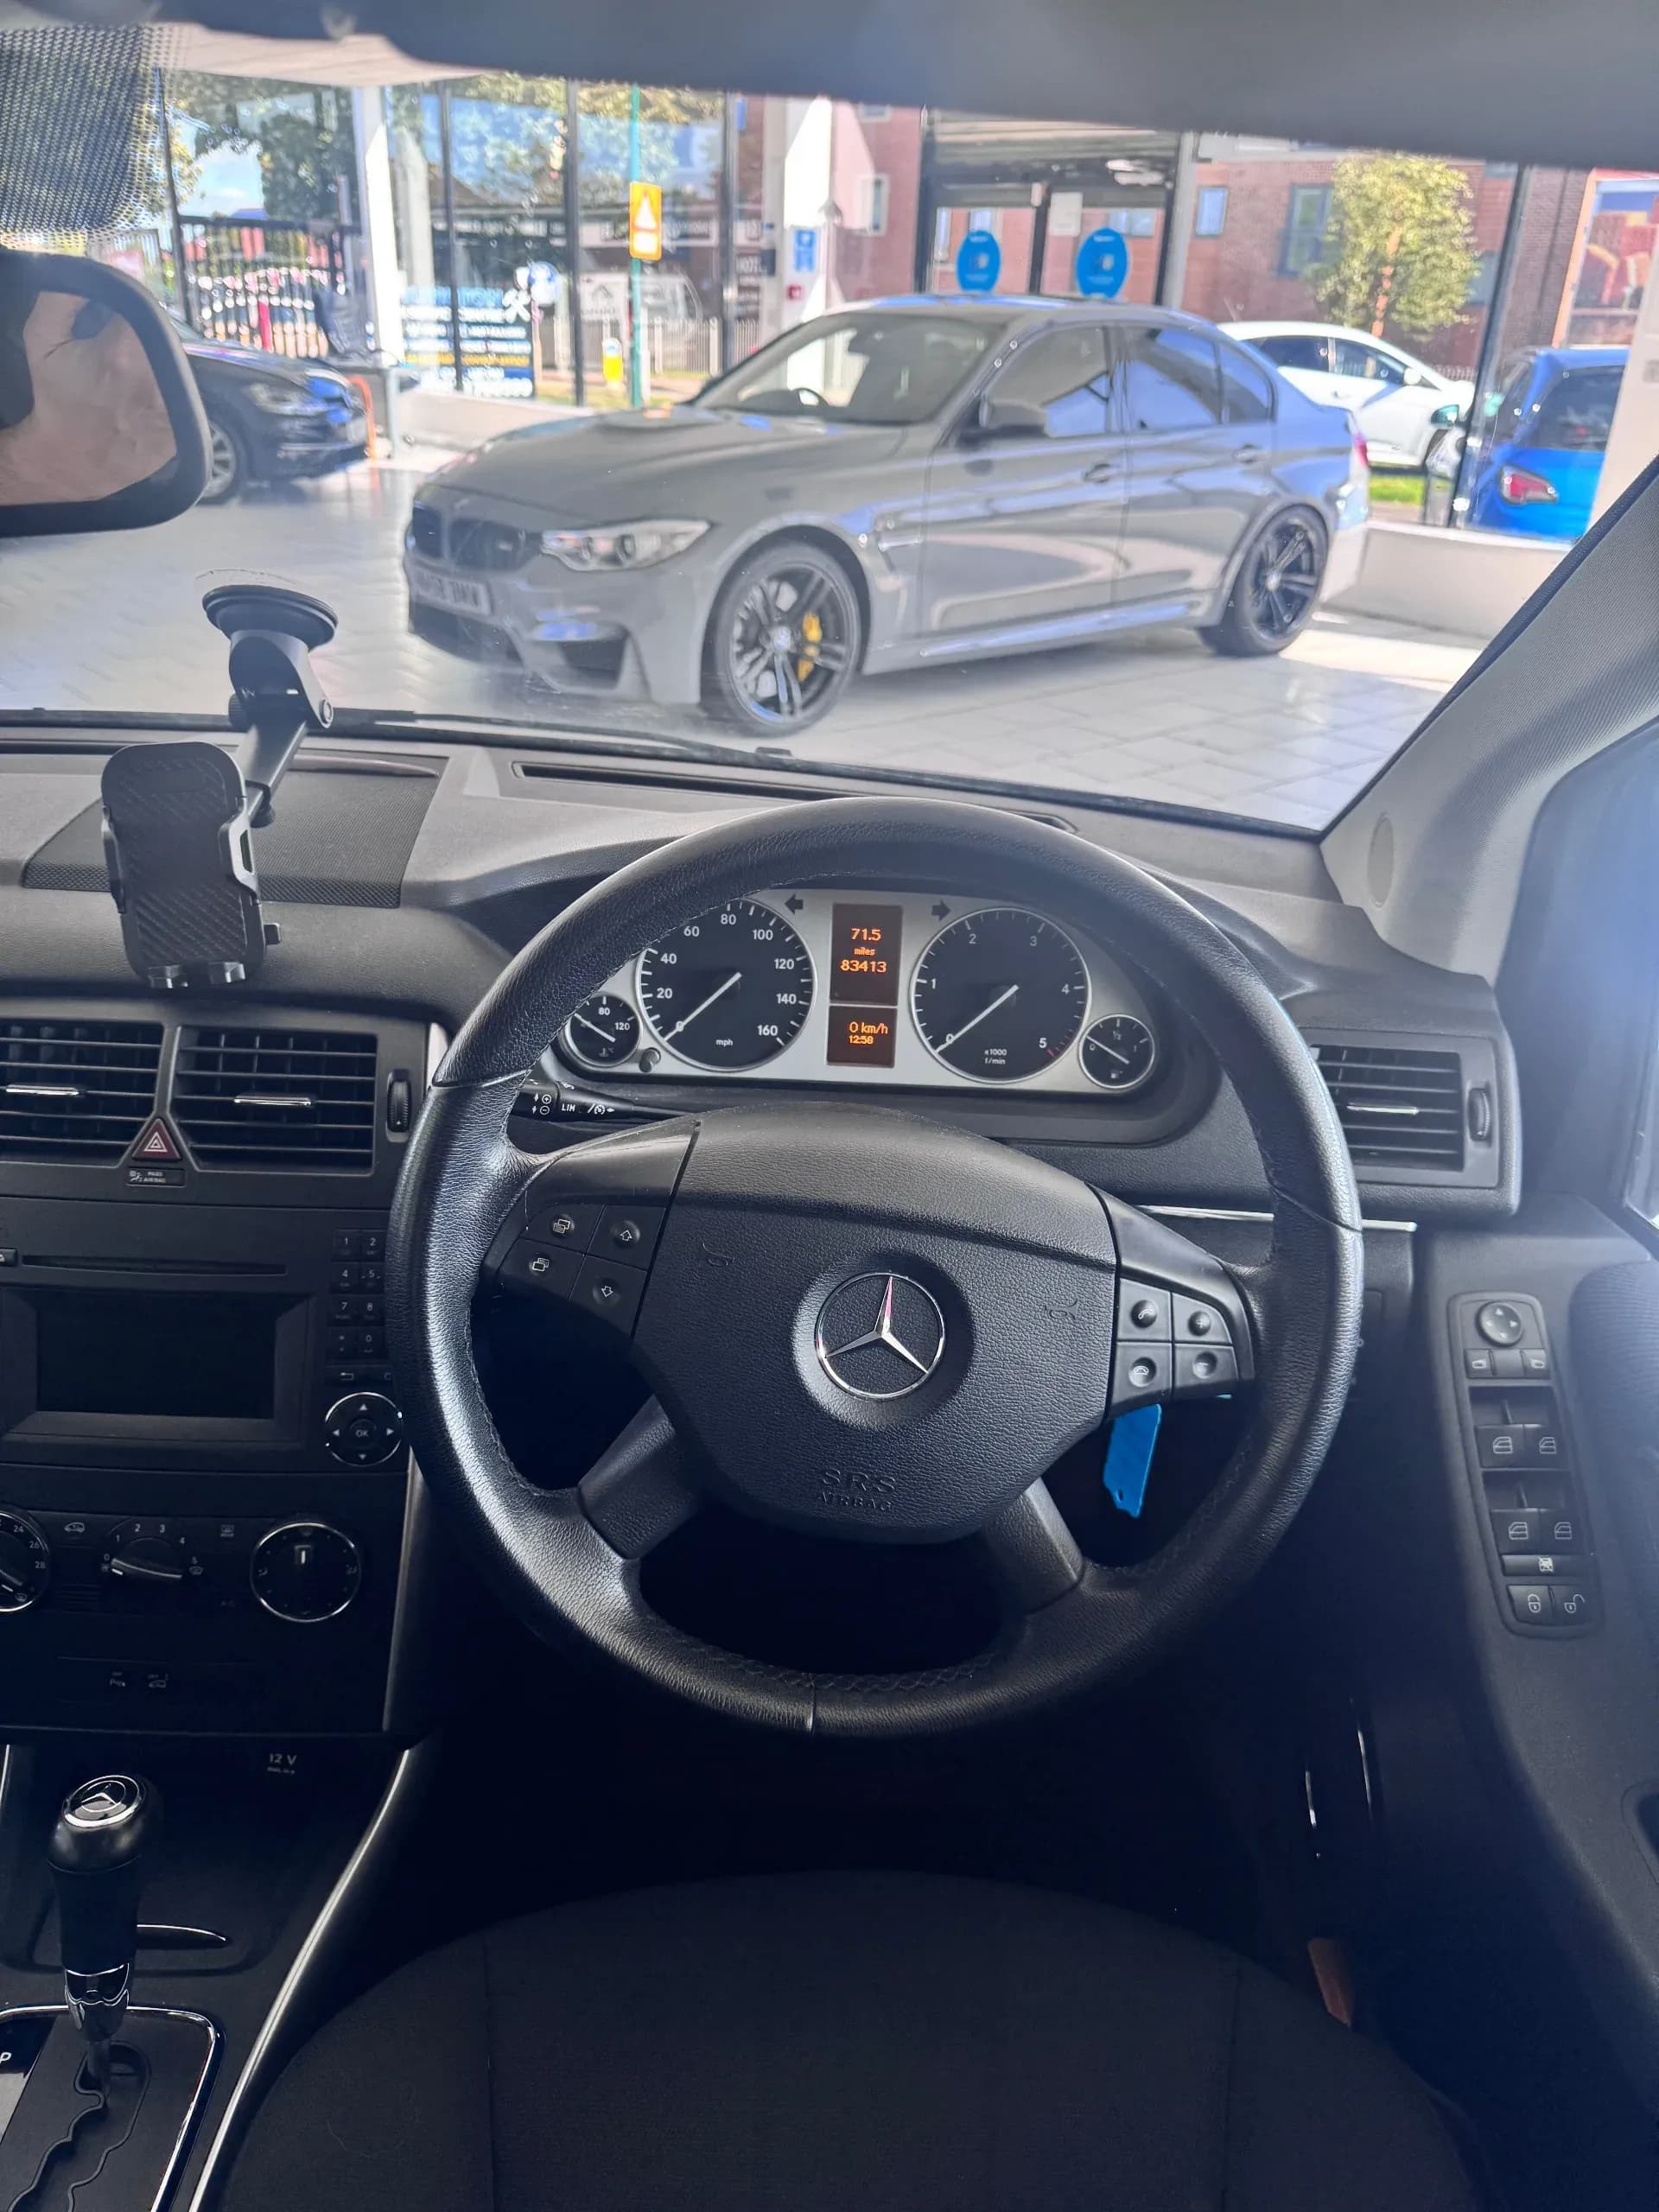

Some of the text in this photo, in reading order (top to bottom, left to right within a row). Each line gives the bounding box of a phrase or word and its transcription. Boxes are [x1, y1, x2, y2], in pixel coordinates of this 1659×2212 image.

[720, 914, 737, 925] 80
[683, 926, 700, 938] 60
[753, 929, 774, 941] 100
[850, 928, 882, 941] 71.5
[969, 933, 977, 944] 2
[1029, 936, 1038, 947] 3
[854, 946, 875, 957] miles
[660, 953, 677, 965] 40
[773, 958, 795, 970] 120
[840, 959, 887, 974] 83413
[931, 977, 937, 989] 1
[1061, 982, 1071, 995] 4
[656, 988, 673, 1000] 20
[776, 993, 797, 1005] 140
[598, 1007, 611, 1016] 80
[614, 1021, 631, 1031] 120
[757, 1025, 779, 1037] 160
[849, 1021, 888, 1035] 0 km/h
[715, 1037, 734, 1048] mph
[848, 1035, 874, 1045] 12:58
[945, 1033, 955, 1045] 0
[1039, 1037, 1047, 1049] 5
[1089, 1043, 1096, 1052] 0
[561, 1103, 576, 1113] LIM
[369, 1237, 378, 1247] 2
[341, 1268, 348, 1279] 4
[368, 1269, 375, 1279] 5
[340, 1301, 348, 1311] 7
[366, 1302, 373, 1312] 8
[355, 1428, 369, 1438] OK
[822, 1467, 895, 1494] SRS
[13, 1524, 24, 1534] 24
[135, 1523, 141, 1533] 2
[159, 1524, 166, 1534] 3
[29, 1540, 40, 1549] 26
[179, 1536, 186, 1545] 4
[34, 1560, 47, 1570] 28
[269, 1752, 298, 1766] 12 V
[0, 2051, 12, 2064] P
